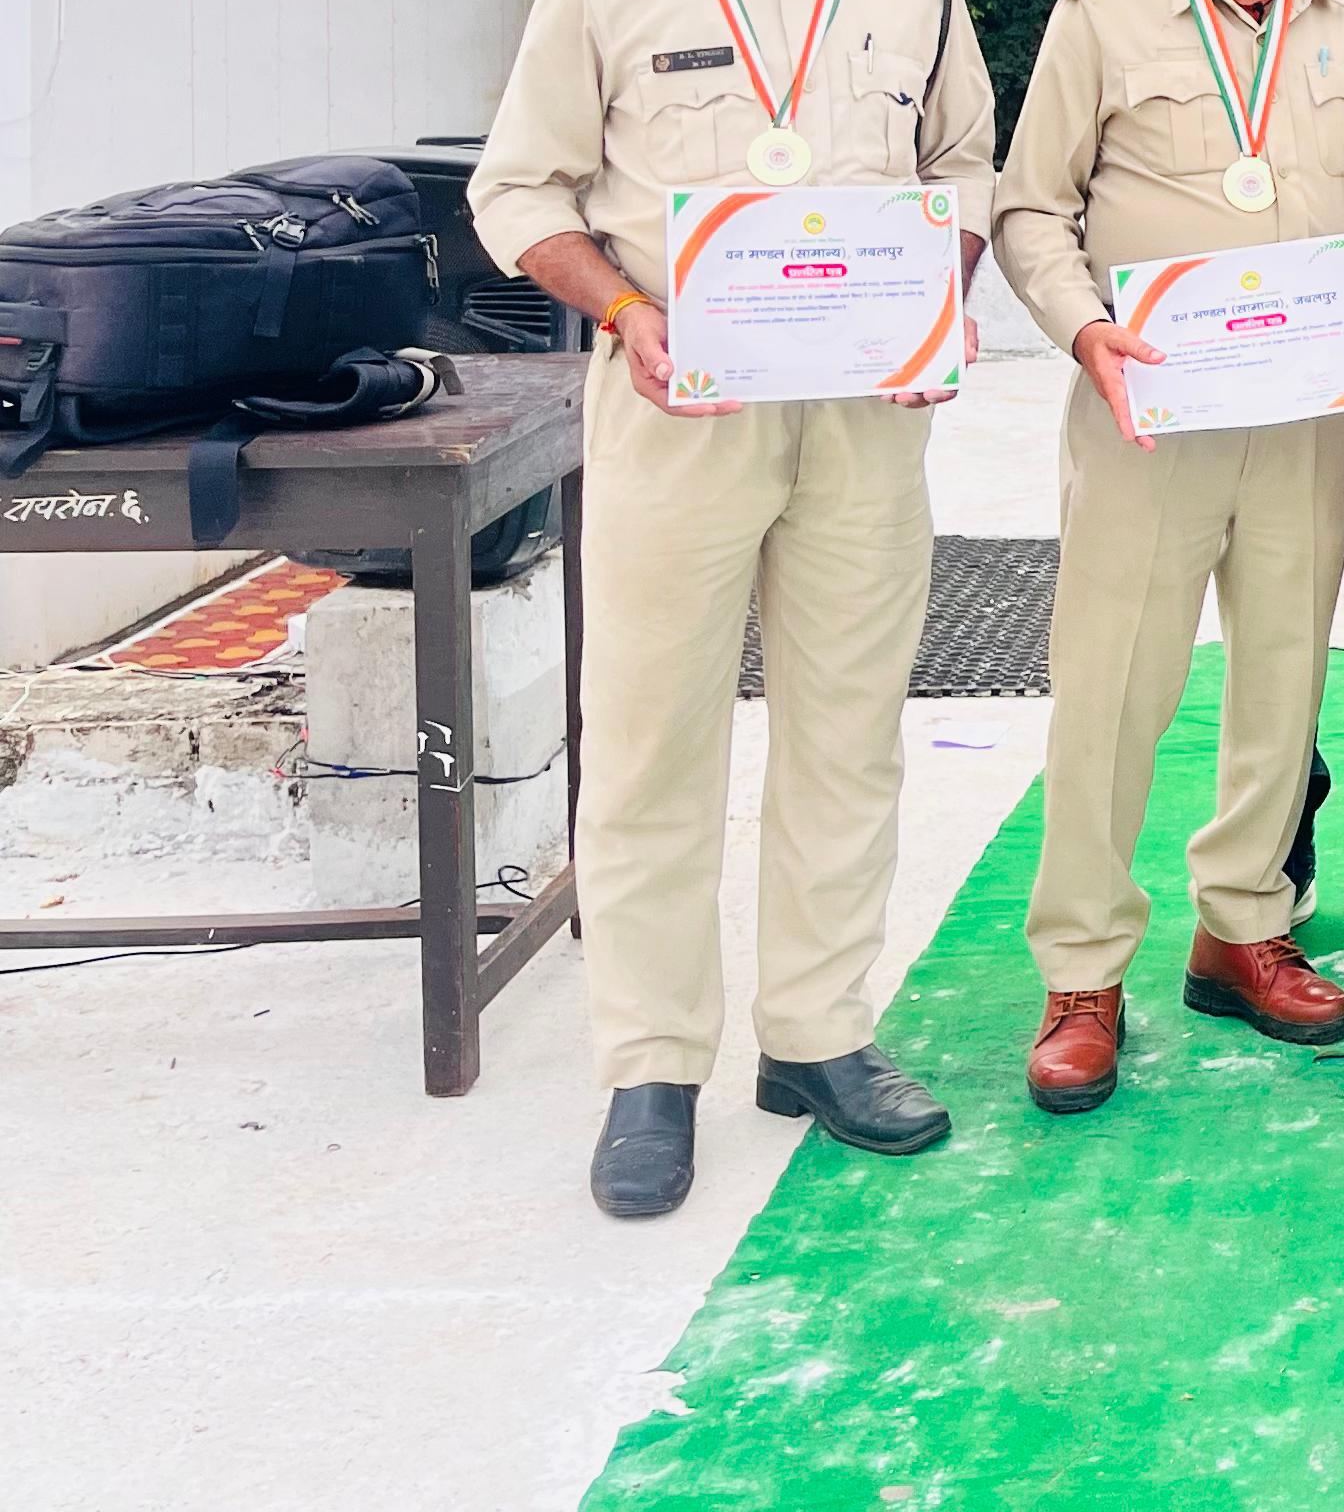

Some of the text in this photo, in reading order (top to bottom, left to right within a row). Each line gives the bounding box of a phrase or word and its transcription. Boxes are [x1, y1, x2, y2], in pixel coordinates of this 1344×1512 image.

[725, 246, 905, 261] वन मण्डल (सामान्य), जबलपुर
[1293, 291, 1338, 305] जबलपुर
